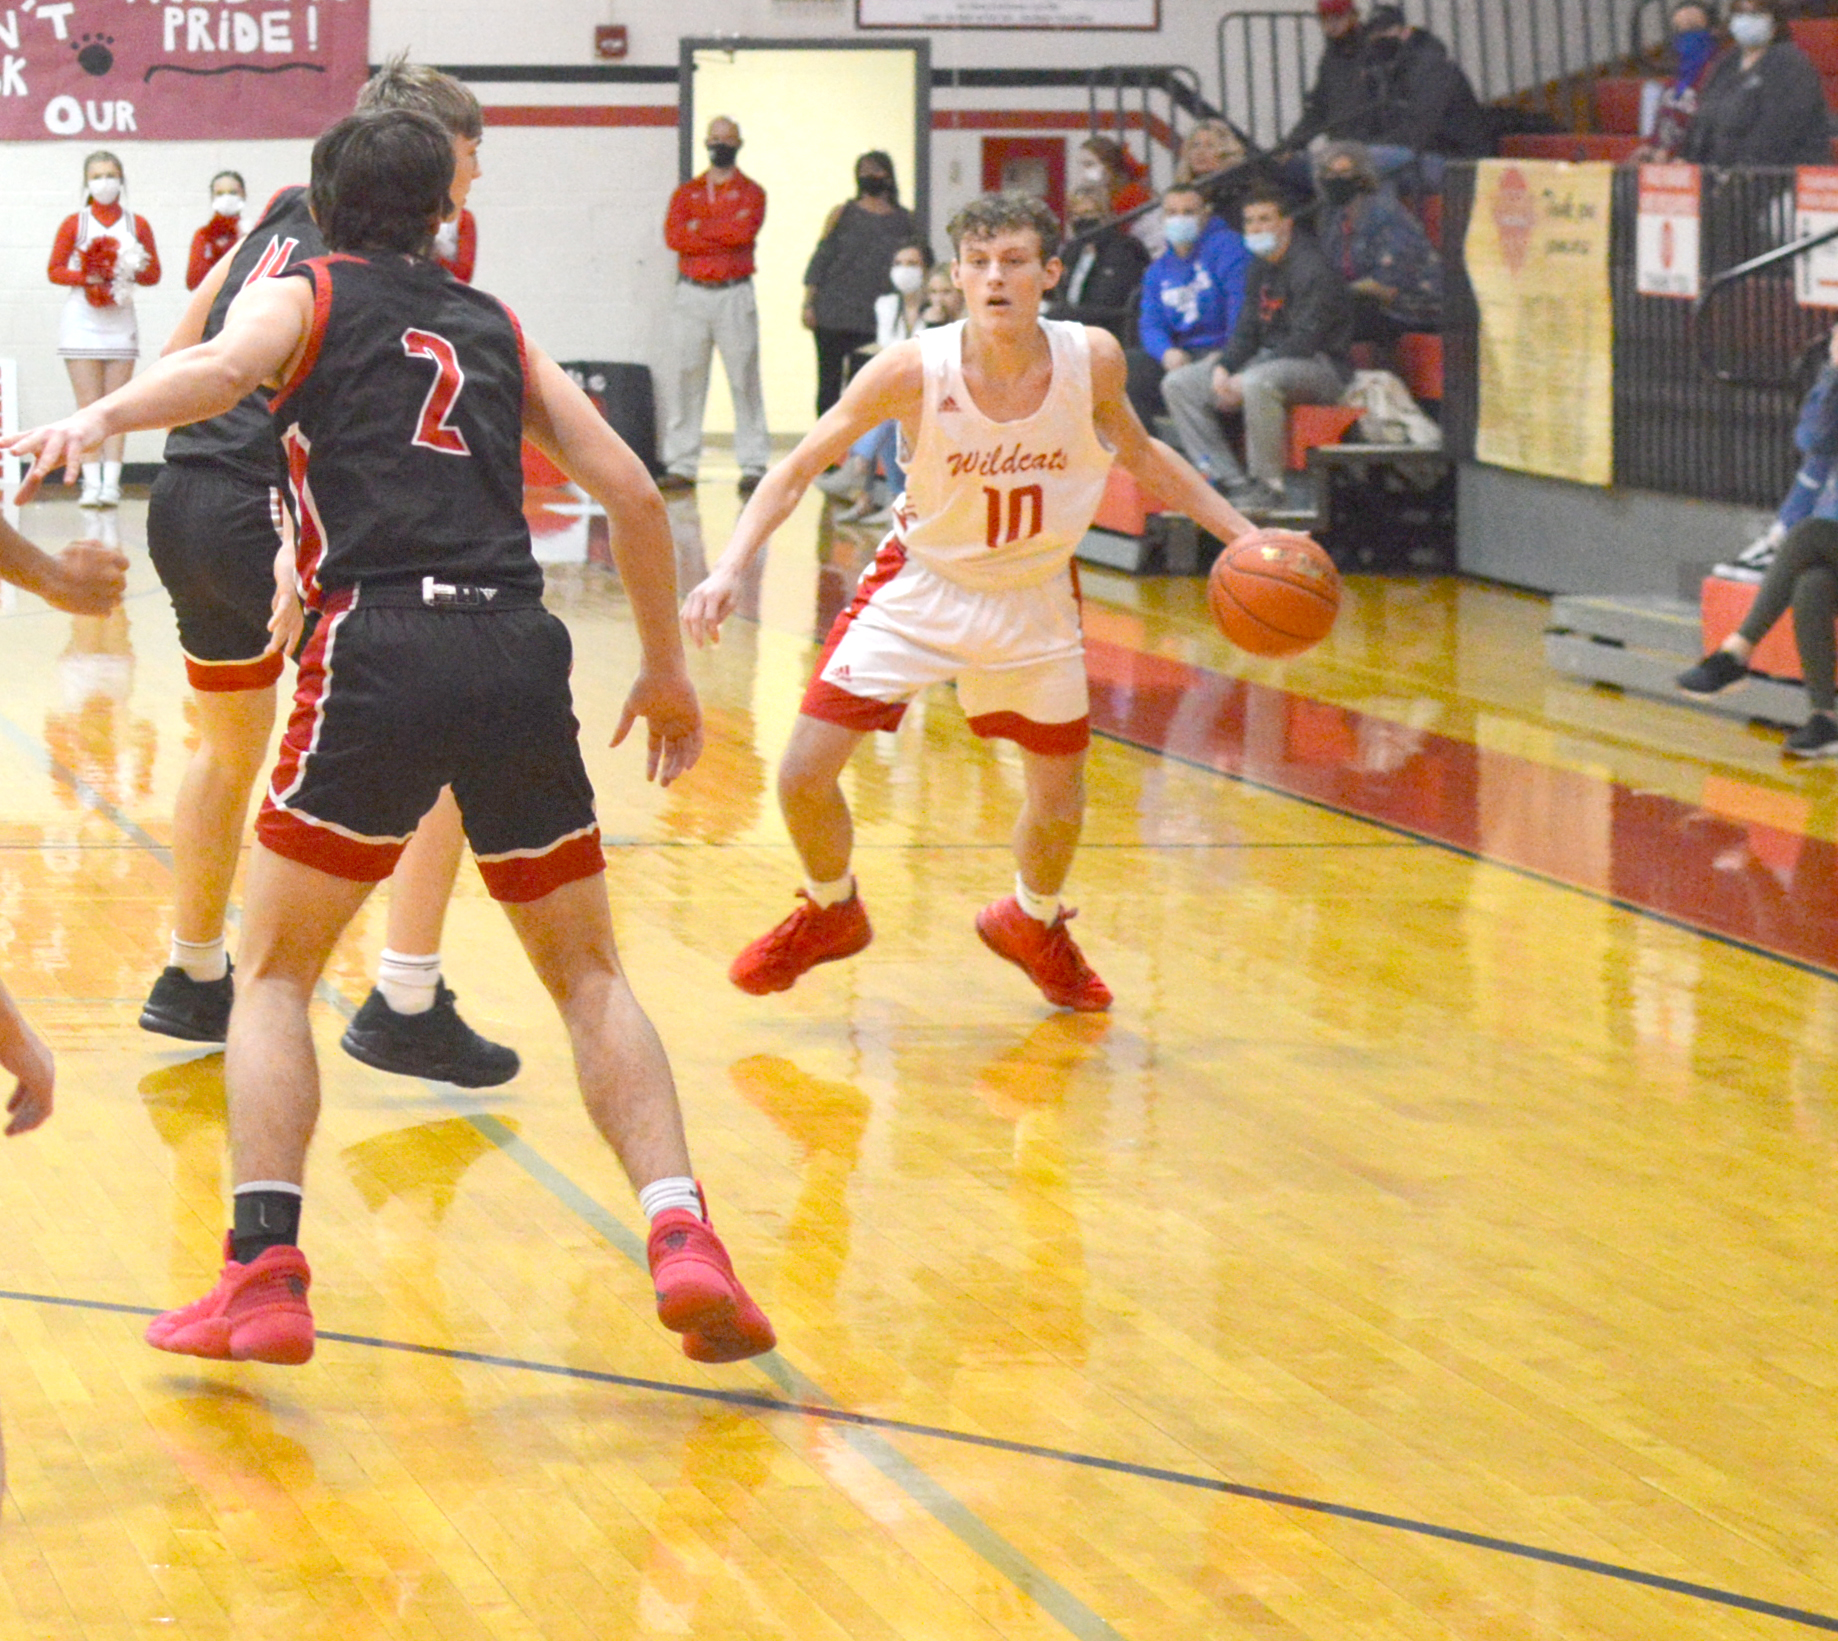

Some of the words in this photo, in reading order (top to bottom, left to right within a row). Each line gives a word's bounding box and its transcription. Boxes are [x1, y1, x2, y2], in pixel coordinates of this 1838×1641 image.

[43, 95, 138, 135] OUR
[401, 327, 471, 455] 2
[946, 442, 1068, 477] Wildcats
[982, 484, 1043, 548] 10
